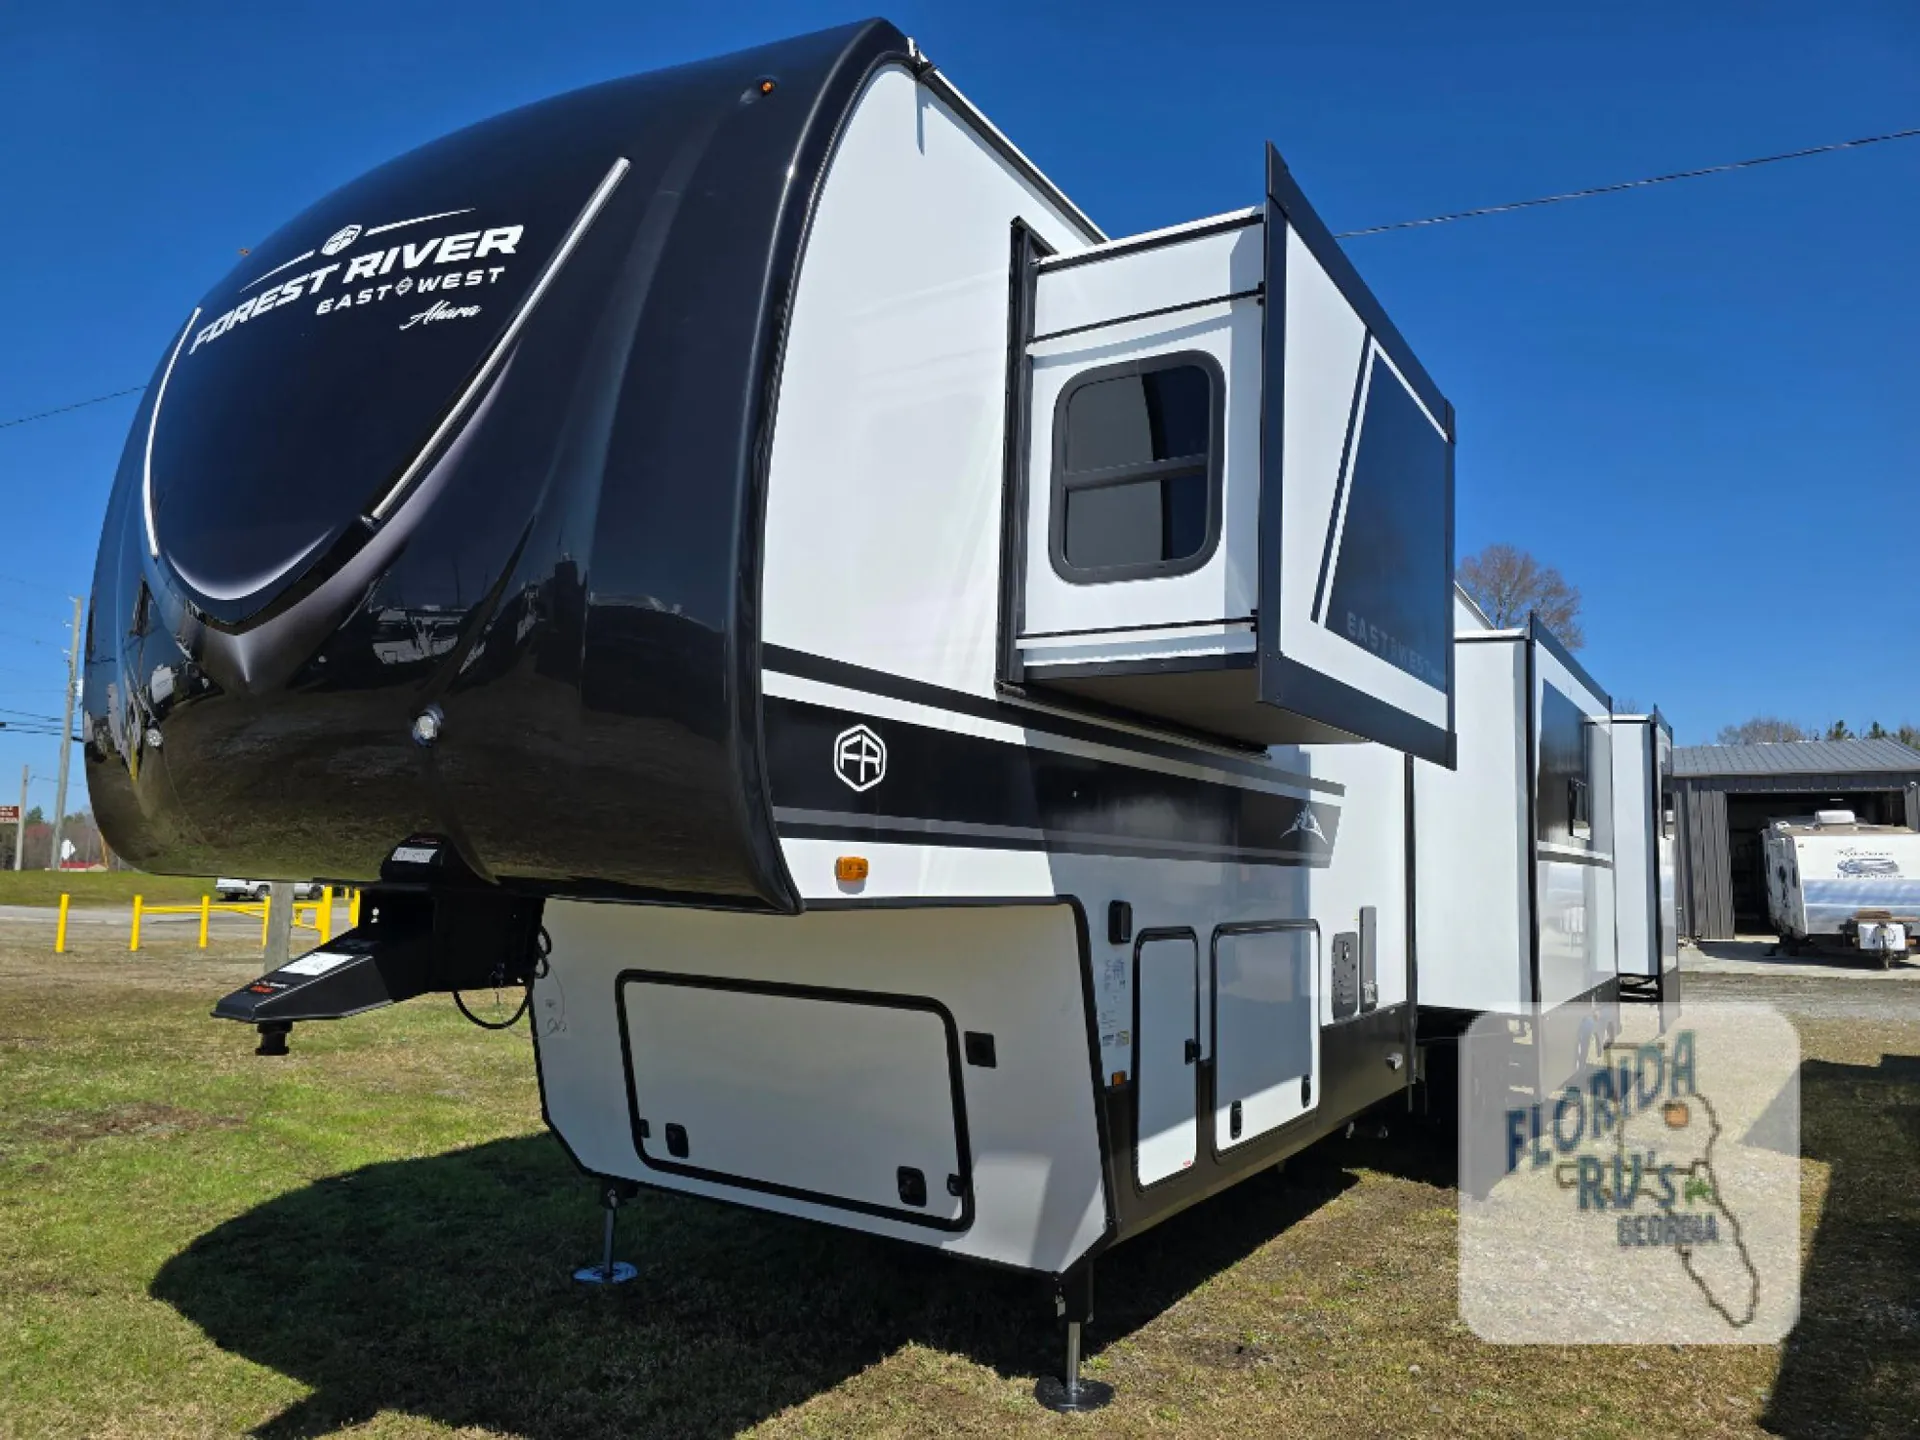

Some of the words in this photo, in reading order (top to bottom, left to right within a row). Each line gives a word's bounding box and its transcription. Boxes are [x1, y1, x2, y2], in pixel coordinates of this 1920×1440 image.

[188, 263, 342, 356] FOREST
[342, 225, 524, 284] RIVER
[316, 284, 393, 316] EAST
[417, 266, 505, 294] WEST
[1346, 610, 1389, 656] EAST
